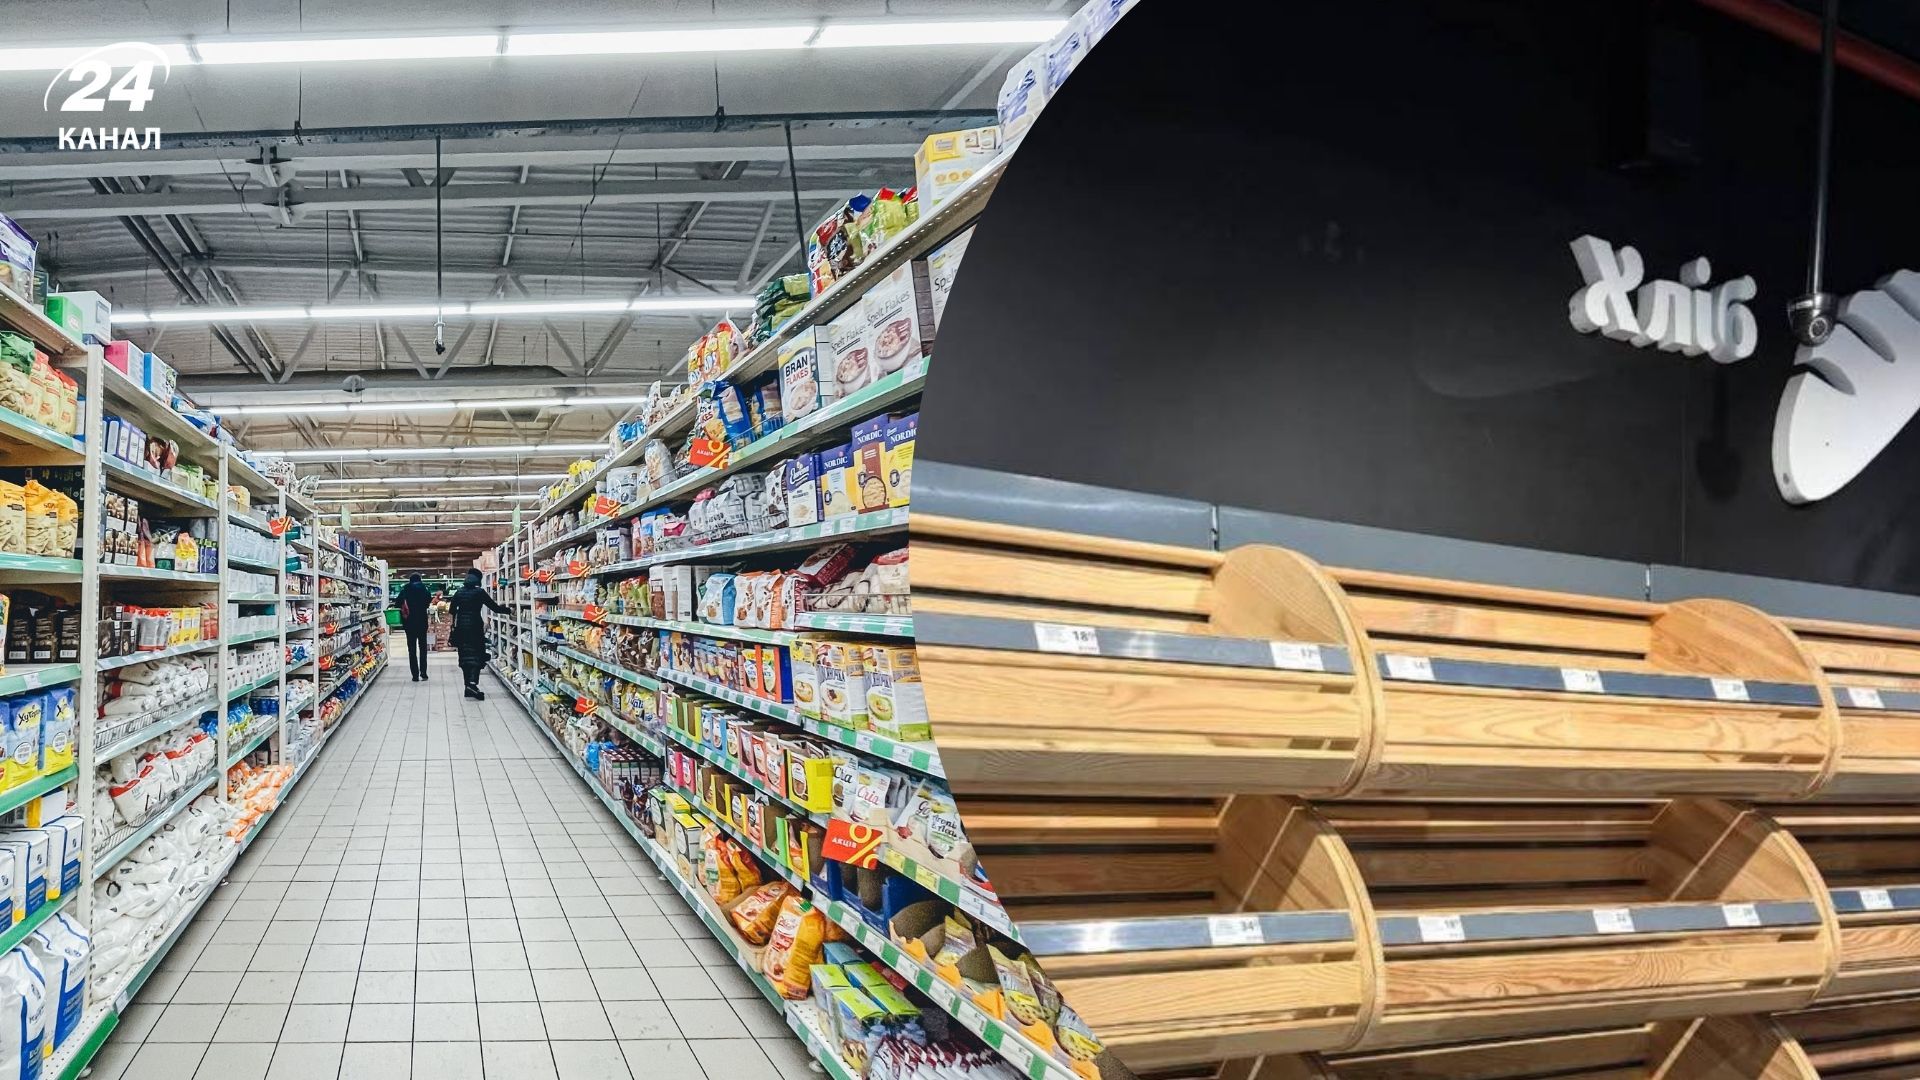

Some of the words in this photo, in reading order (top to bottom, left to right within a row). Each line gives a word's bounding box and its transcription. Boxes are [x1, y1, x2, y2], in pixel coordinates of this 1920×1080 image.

[1569, 234, 1758, 363] Хліб
[785, 354, 808, 377] BRAN
[785, 367, 809, 385] FLAKES
[857, 429, 883, 444] NORDIC
[824, 456, 848, 469] NORDIC
[832, 837, 857, 849] АКЦІЯ
